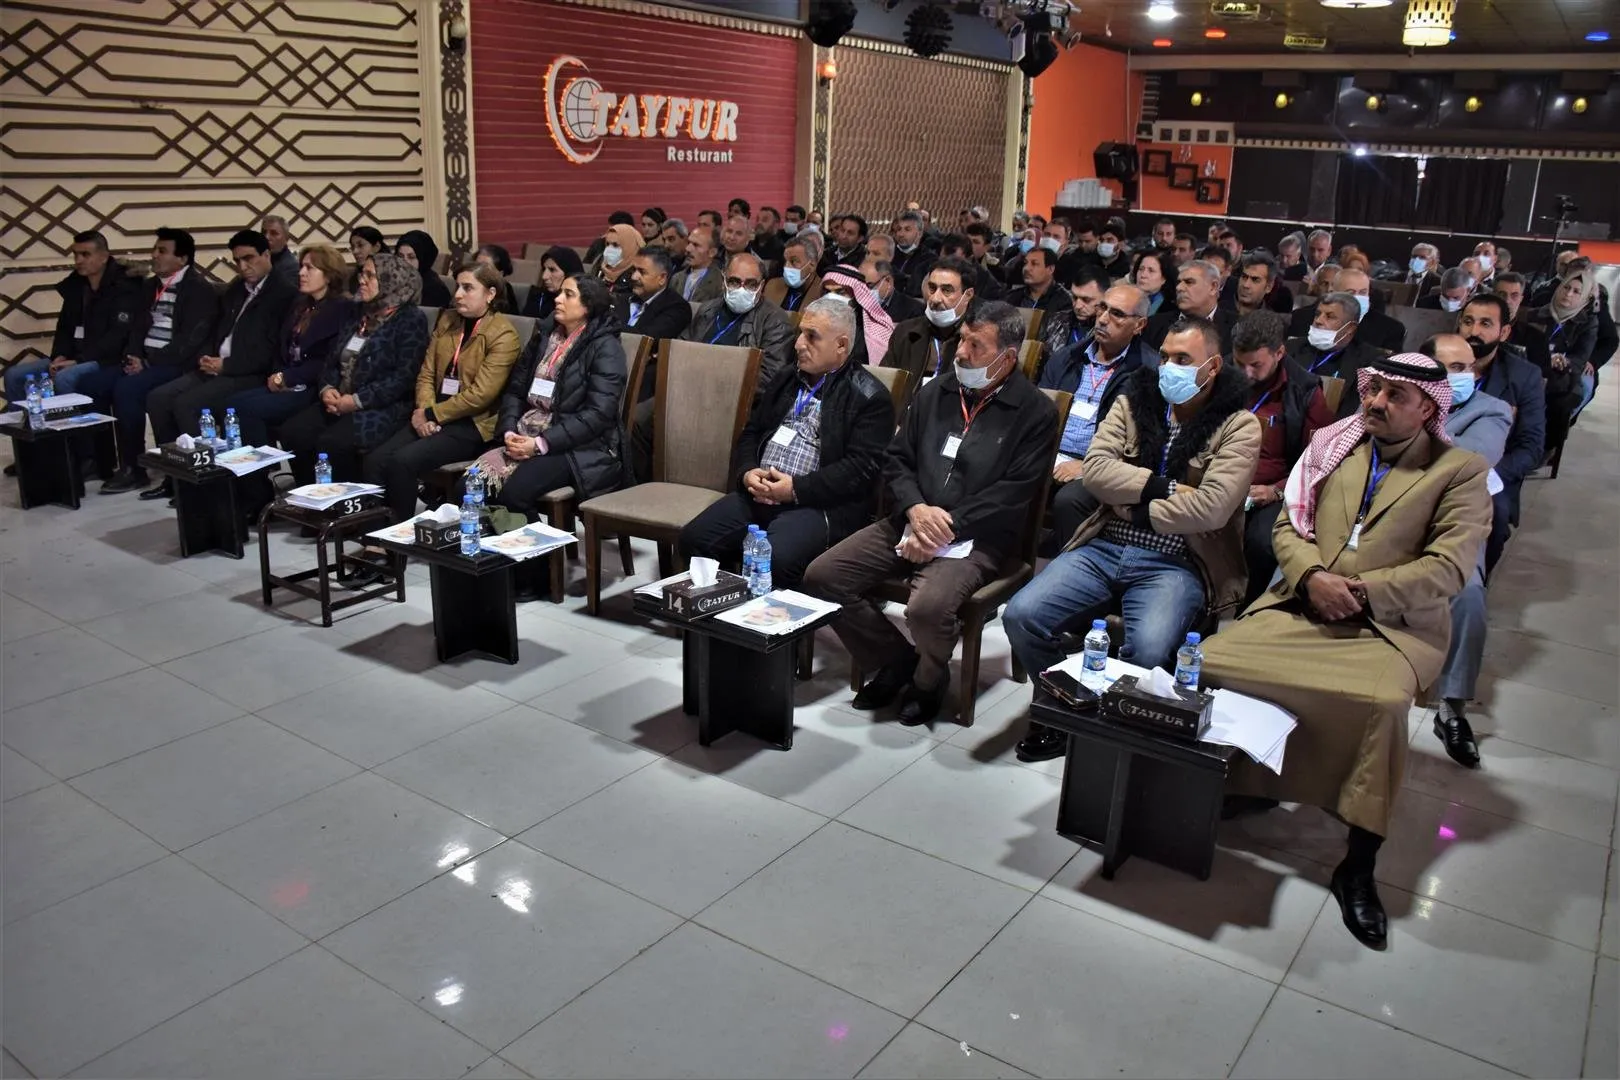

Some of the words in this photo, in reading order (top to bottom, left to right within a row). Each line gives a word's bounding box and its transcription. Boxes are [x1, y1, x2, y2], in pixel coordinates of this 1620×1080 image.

[593, 92, 739, 141] TAYFUR
[667, 146, 733, 163] Resturant
[193, 450, 211, 467] 25
[344, 498, 362, 515] 35
[420, 528, 433, 545] 15
[668, 593, 684, 614] 14
[706, 591, 741, 608] TAYFUR
[1130, 705, 1185, 727] TAYFUR
